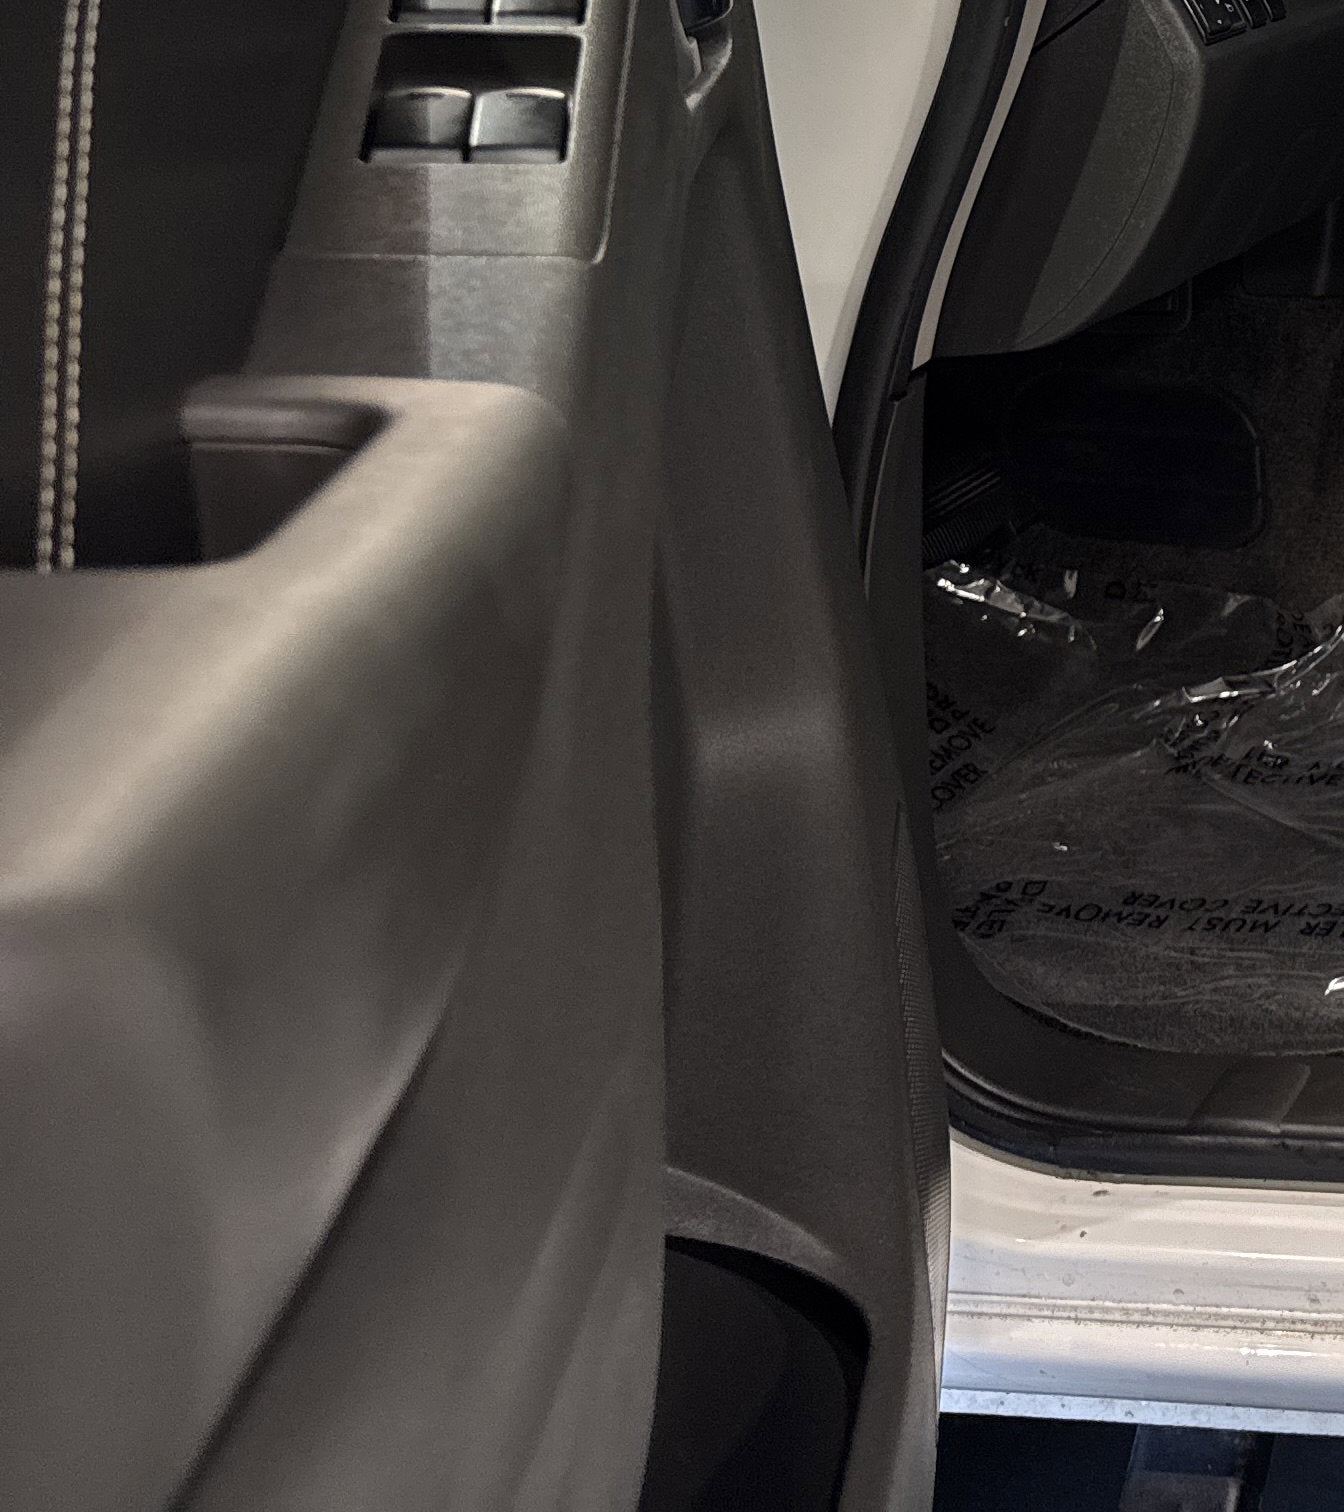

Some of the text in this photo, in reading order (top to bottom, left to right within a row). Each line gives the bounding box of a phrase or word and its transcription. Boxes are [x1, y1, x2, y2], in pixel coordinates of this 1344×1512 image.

[1122, 891, 1228, 913] COVER
[1034, 901, 1168, 929] REMOVE
[1187, 916, 1280, 935] MUST
